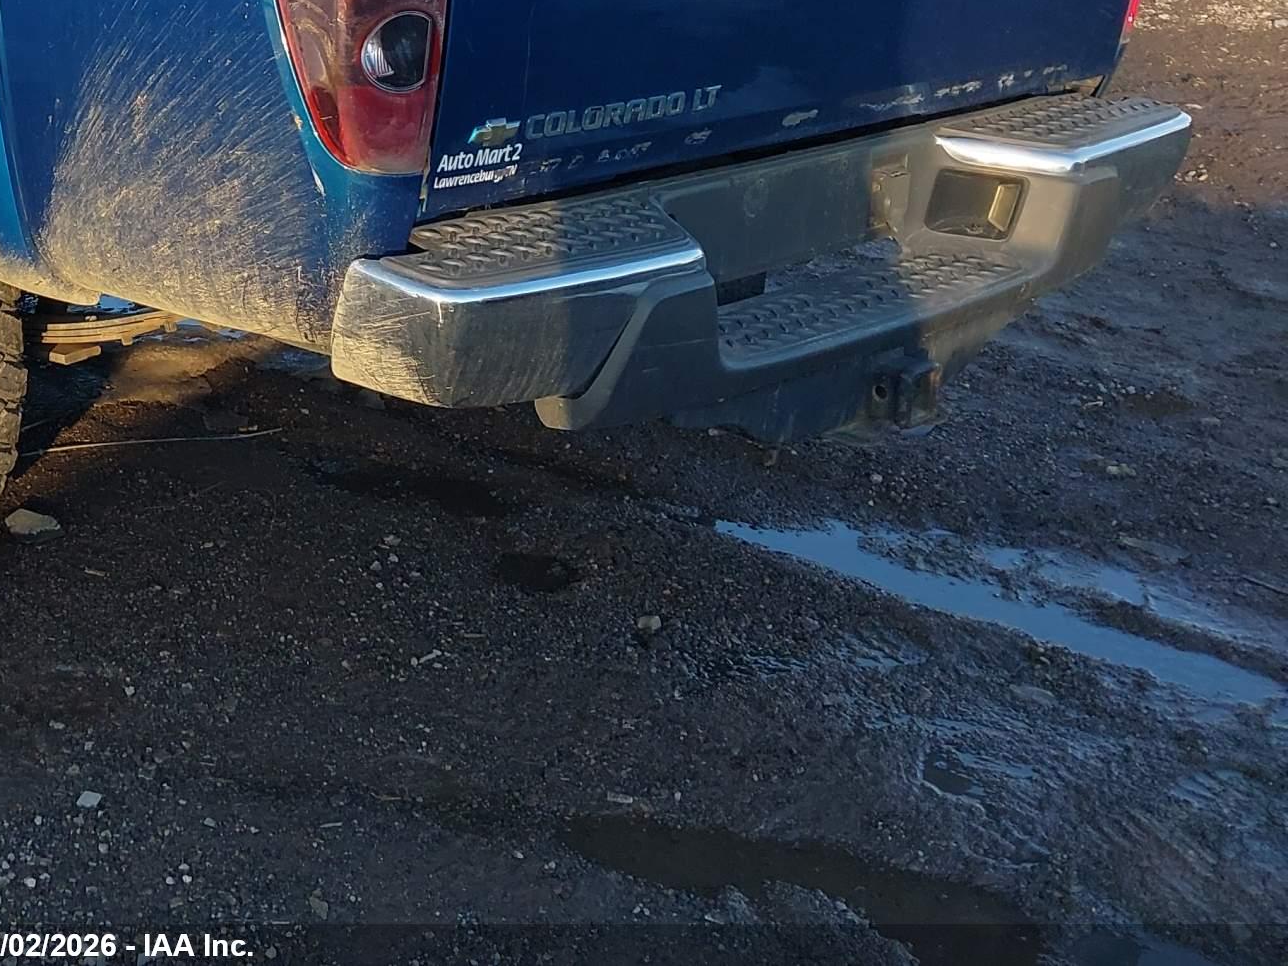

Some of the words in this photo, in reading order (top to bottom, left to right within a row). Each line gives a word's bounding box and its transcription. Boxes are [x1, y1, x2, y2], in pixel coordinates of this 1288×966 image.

[526, 91, 687, 140] COLORADO
[692, 85, 722, 112] LT
[437, 151, 474, 173] Auto
[474, 144, 513, 167] Mart
[512, 143, 523, 161] 2
